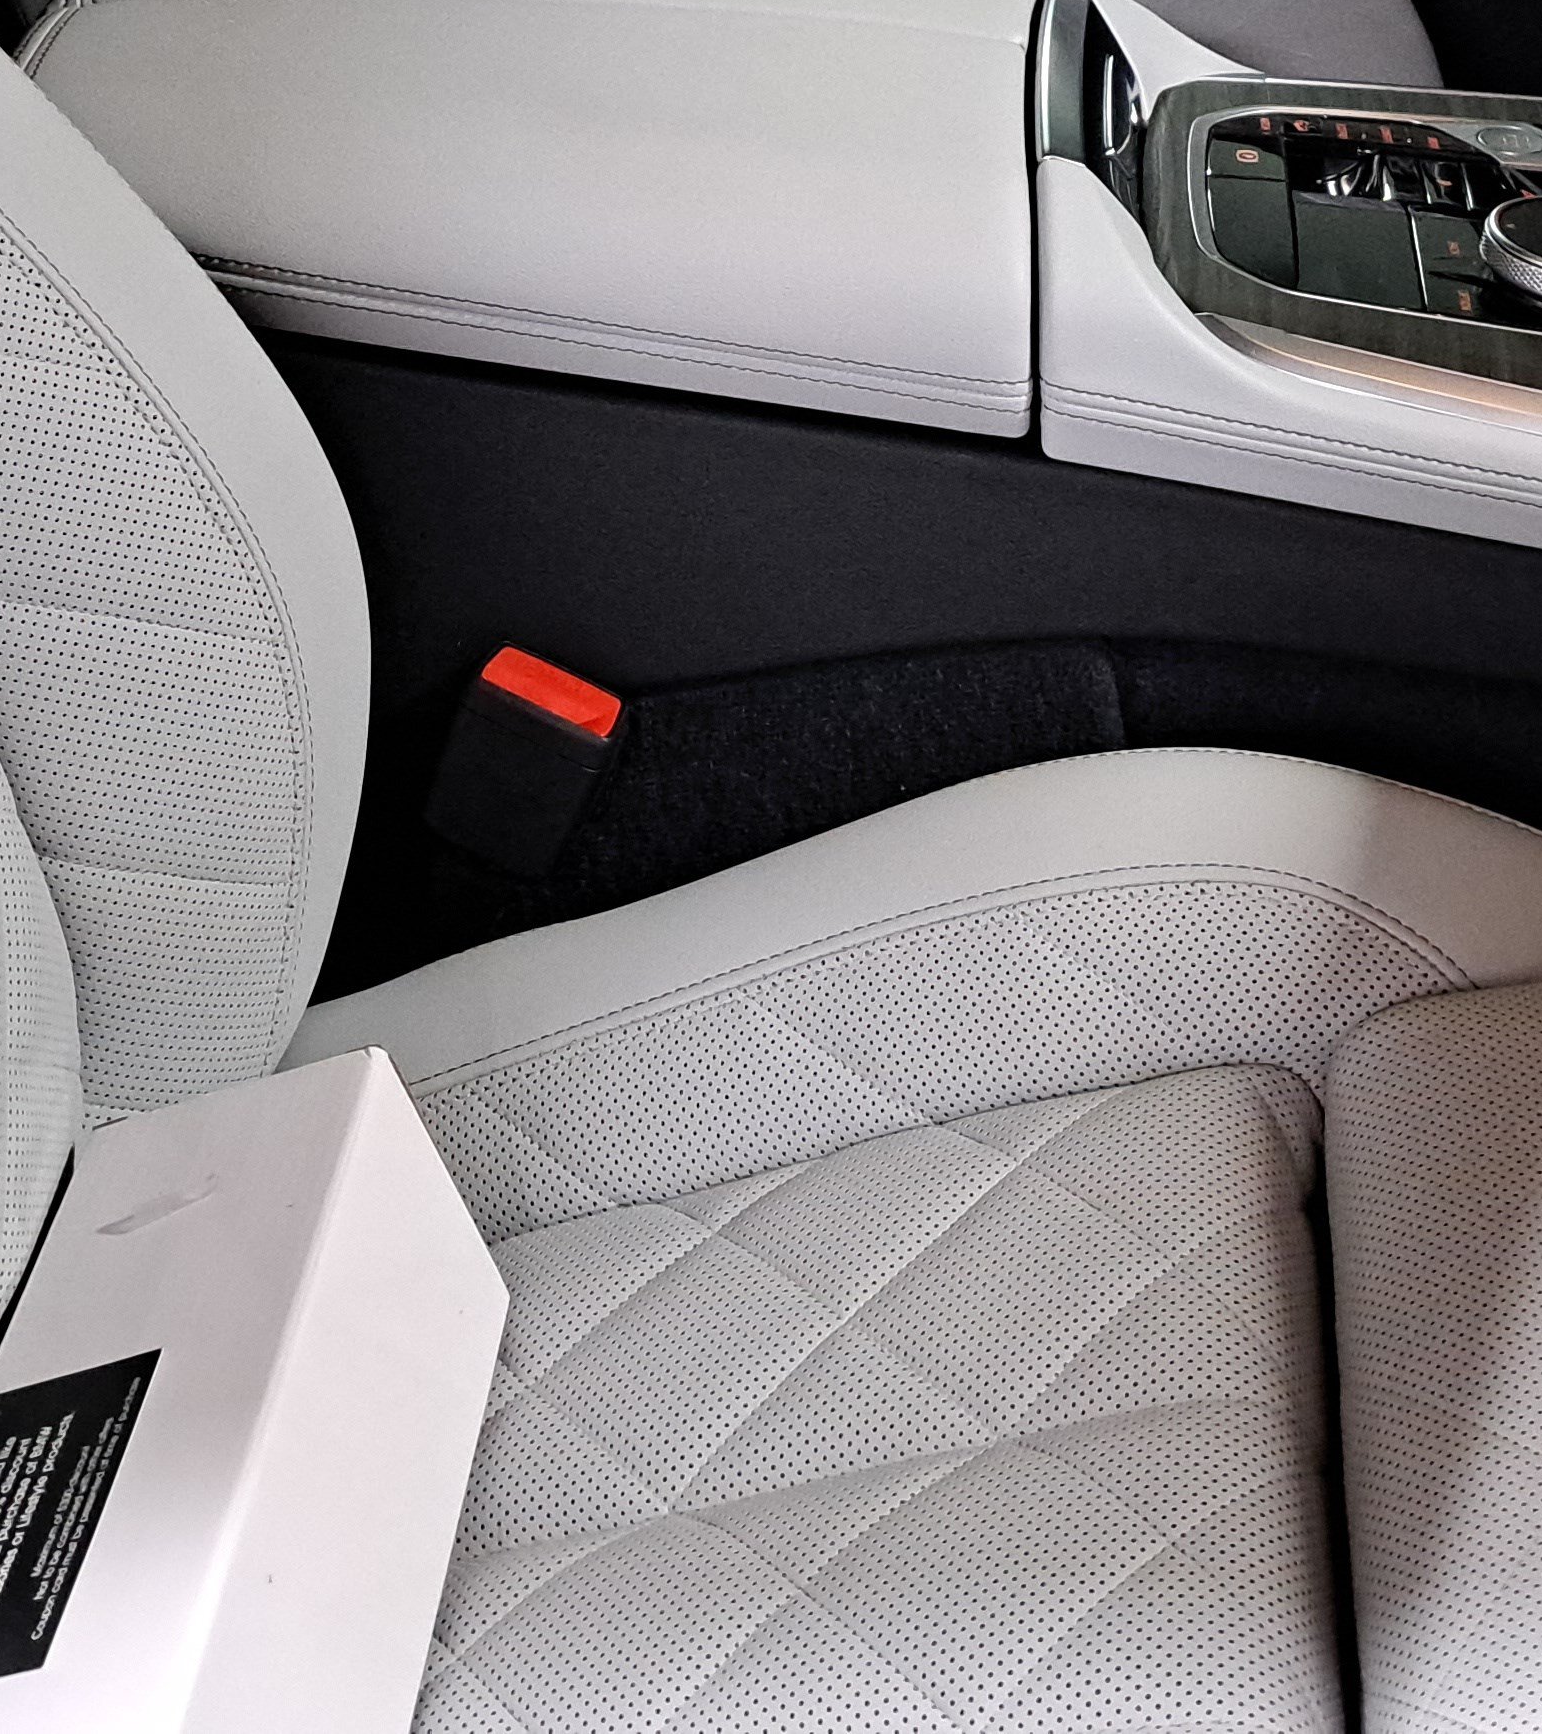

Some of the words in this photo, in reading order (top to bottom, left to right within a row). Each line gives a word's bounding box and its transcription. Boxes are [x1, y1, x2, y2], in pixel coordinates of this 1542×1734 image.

[2, 1437, 16, 1459] like
[31, 1427, 52, 1458] BMW
[1, 1438, 31, 1493] discount
[26, 1461, 38, 1474] of
[16, 1476, 48, 1528] Lifestyle
[12, 1532, 25, 1546] or
[31, 1595, 56, 1640] Coupon
[52, 1567, 68, 1593] card
